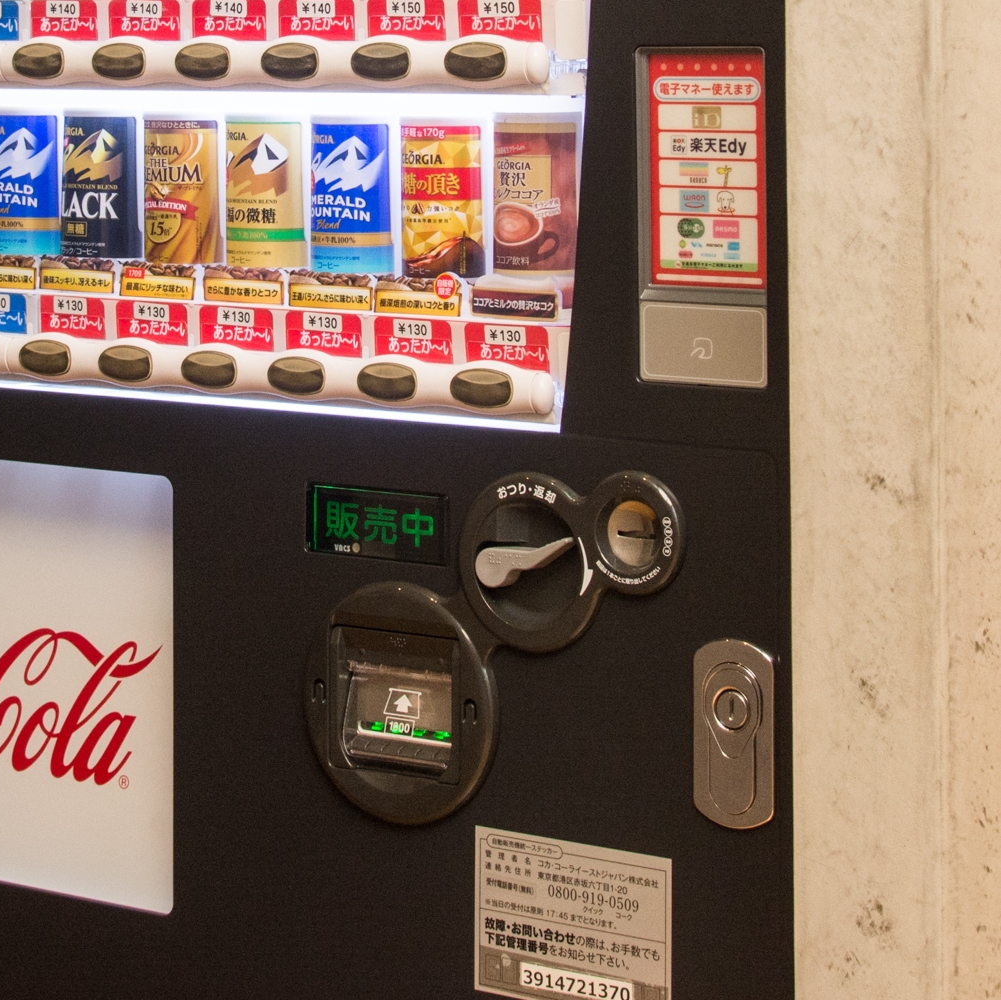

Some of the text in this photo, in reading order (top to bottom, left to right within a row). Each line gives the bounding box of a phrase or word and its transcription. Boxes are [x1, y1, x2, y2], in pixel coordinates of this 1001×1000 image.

[50, 3, 76, 15] ¥140
[131, 3, 158, 15] ¥140
[215, 2, 243, 14] ¥140
[302, 2, 331, 15] ¥140
[391, 1, 421, 14] ¥150
[483, 1, 515, 14] ¥150
[659, 83, 755, 96] 電子マネー使えます
[672, 144, 685, 152] Edy
[690, 138, 747, 156] 楽天Edy
[150, 158, 168, 168] THE
[496, 158, 533, 171] GEORGIA
[499, 171, 527, 188] 贅沢
[62, 191, 120, 220] LACK
[158, 201, 188, 212] EDITION
[66, 223, 85, 235] 無糖
[315, 219, 342, 231] Blend
[317, 261, 340, 270] コーヒー
[496, 254, 530, 266] ココア飲料
[409, 266, 431, 275] コーヒー
[43, 275, 111, 288] 後味スッキリ、冴えるキレ
[125, 281, 189, 294] 最高にリッチな味わい
[207, 285, 279, 298] さらに豊かな香りとコク
[437, 287, 452, 296] 限定
[57, 299, 83, 311] ¥130
[473, 297, 554, 311] ココアとミルクの贅沢なコク
[138, 305, 165, 318] ¥130
[222, 310, 251, 323] ¥130
[308, 316, 338, 329] ¥130
[398, 322, 427, 336] ¥130
[489, 329, 521, 342] ¥130
[496, 482, 557, 505] おつり・返却
[325, 499, 434, 548] 販売中
[538, 859, 659, 889] コカ・コーライーストジャパン株式会社
[537, 871, 628, 895] 東京都港区赤坂六丁目1-20
[547, 883, 640, 914] 0800-919-0509
[546, 909, 569, 921] 17:45
[570, 914, 618, 930] までとなります。
[615, 912, 633, 921] コーク
[484, 916, 660, 961] 故障・お問い合わせの際は、お手数でも
[484, 930, 630, 971] 下記管理番号をお知らせ下さい。
[522, 969, 631, 1000] 3914721370
